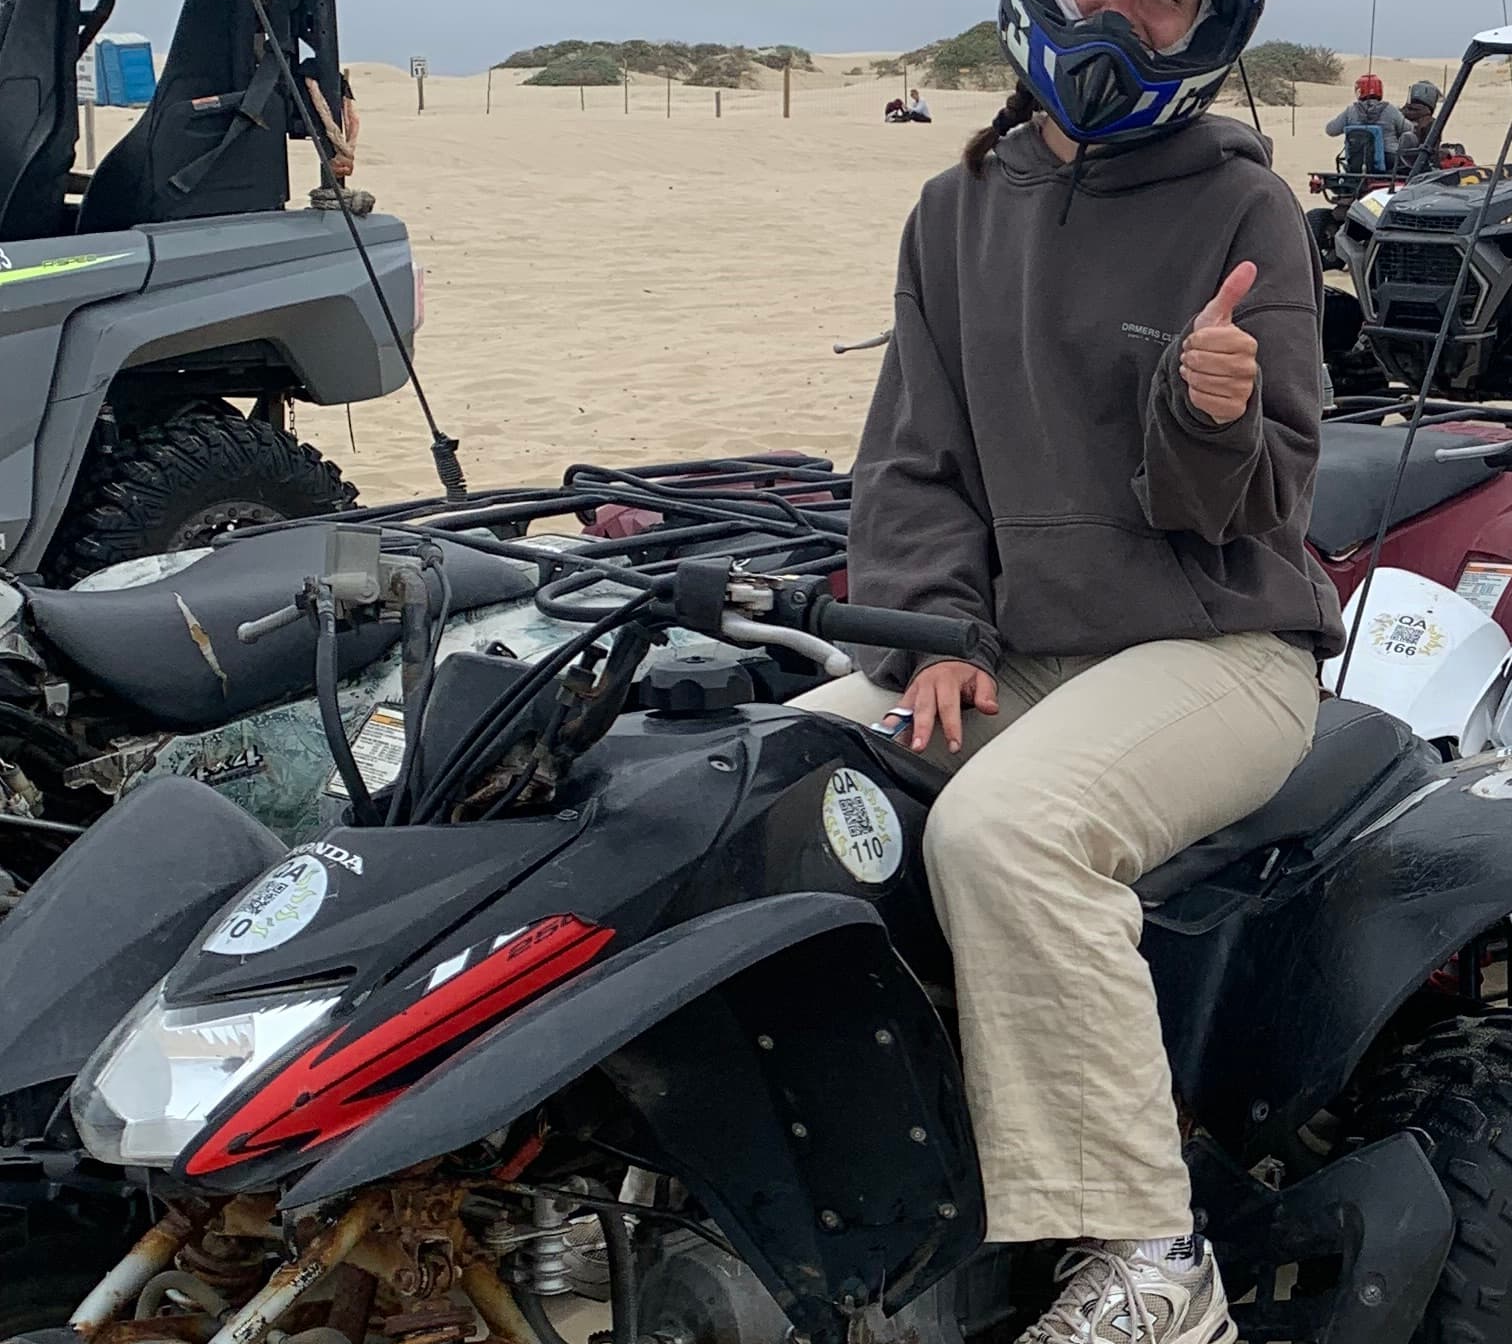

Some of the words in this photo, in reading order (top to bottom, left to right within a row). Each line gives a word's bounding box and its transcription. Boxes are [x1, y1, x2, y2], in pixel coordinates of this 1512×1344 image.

[1399, 615, 1427, 630] QA
[1385, 641, 1417, 656] 166
[832, 771, 858, 794] QA
[852, 836, 884, 864] 110
